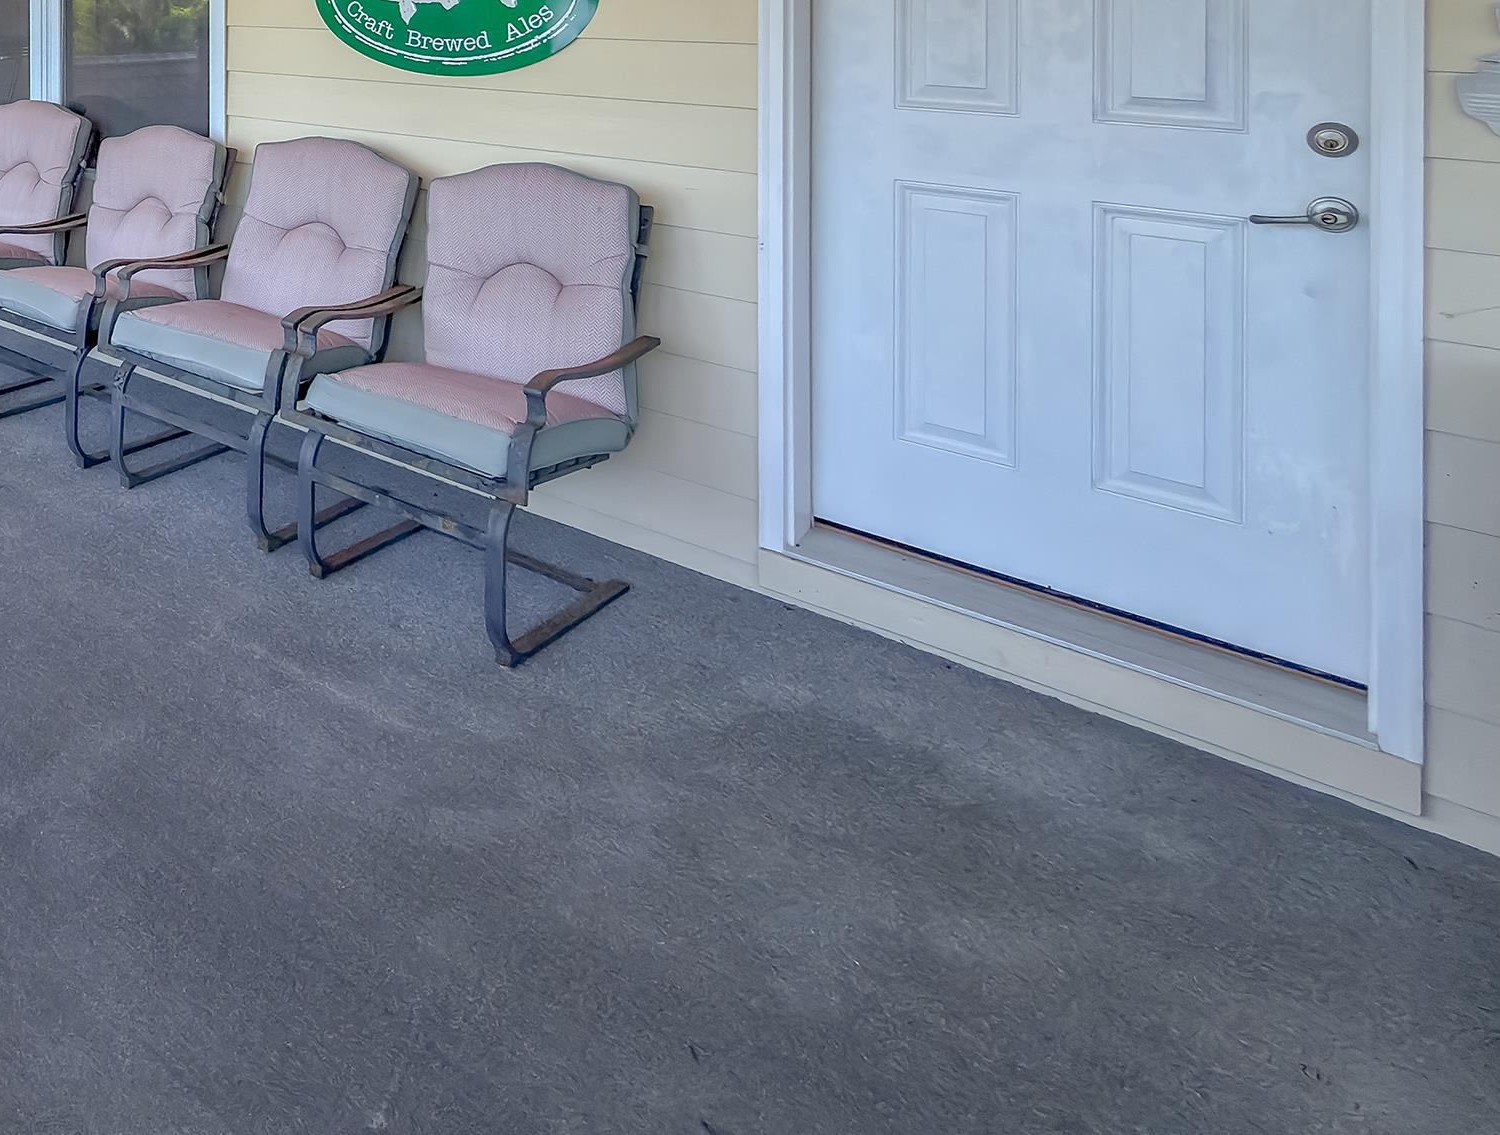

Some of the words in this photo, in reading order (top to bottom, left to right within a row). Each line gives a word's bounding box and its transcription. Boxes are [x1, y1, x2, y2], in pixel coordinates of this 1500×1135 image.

[346, 0, 396, 41] Craft
[405, 29, 492, 52] Brewed
[505, 4, 555, 44] Ales
